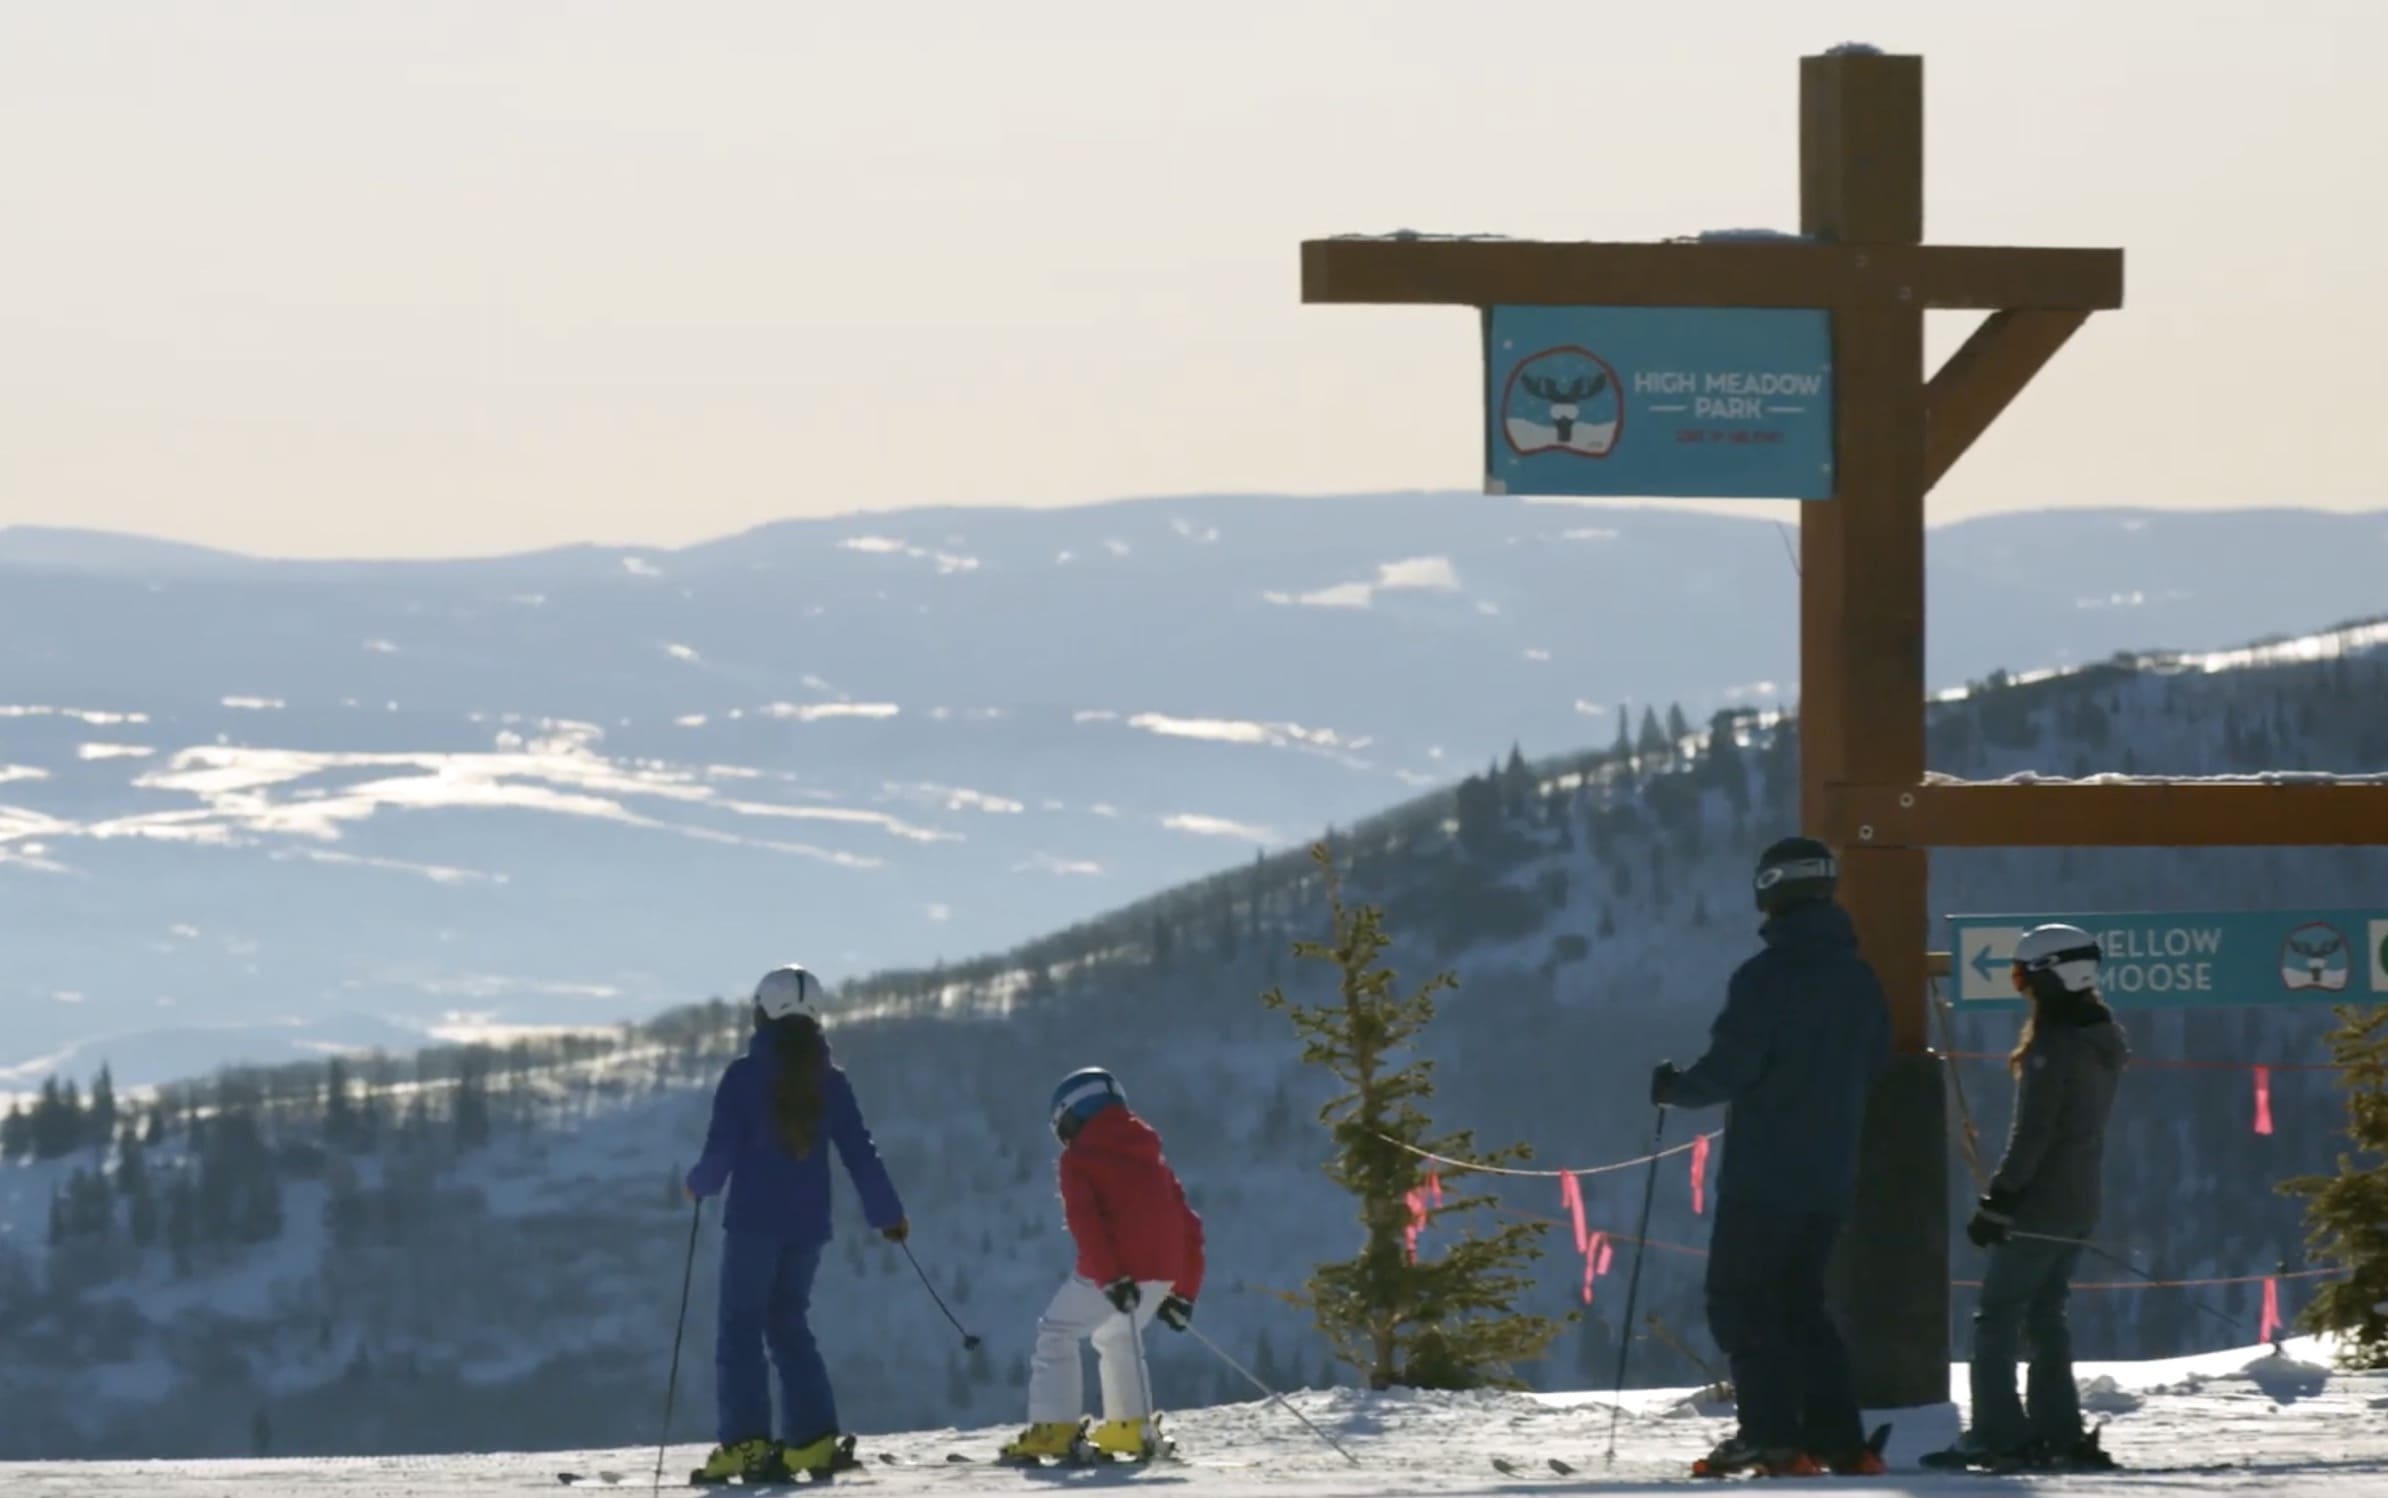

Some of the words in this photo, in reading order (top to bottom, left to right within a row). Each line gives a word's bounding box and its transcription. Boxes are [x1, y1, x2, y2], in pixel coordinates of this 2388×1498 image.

[1635, 371, 1695, 393] HIGH
[1705, 373, 1821, 395] MEADOW
[1695, 397, 1762, 419] PARK
